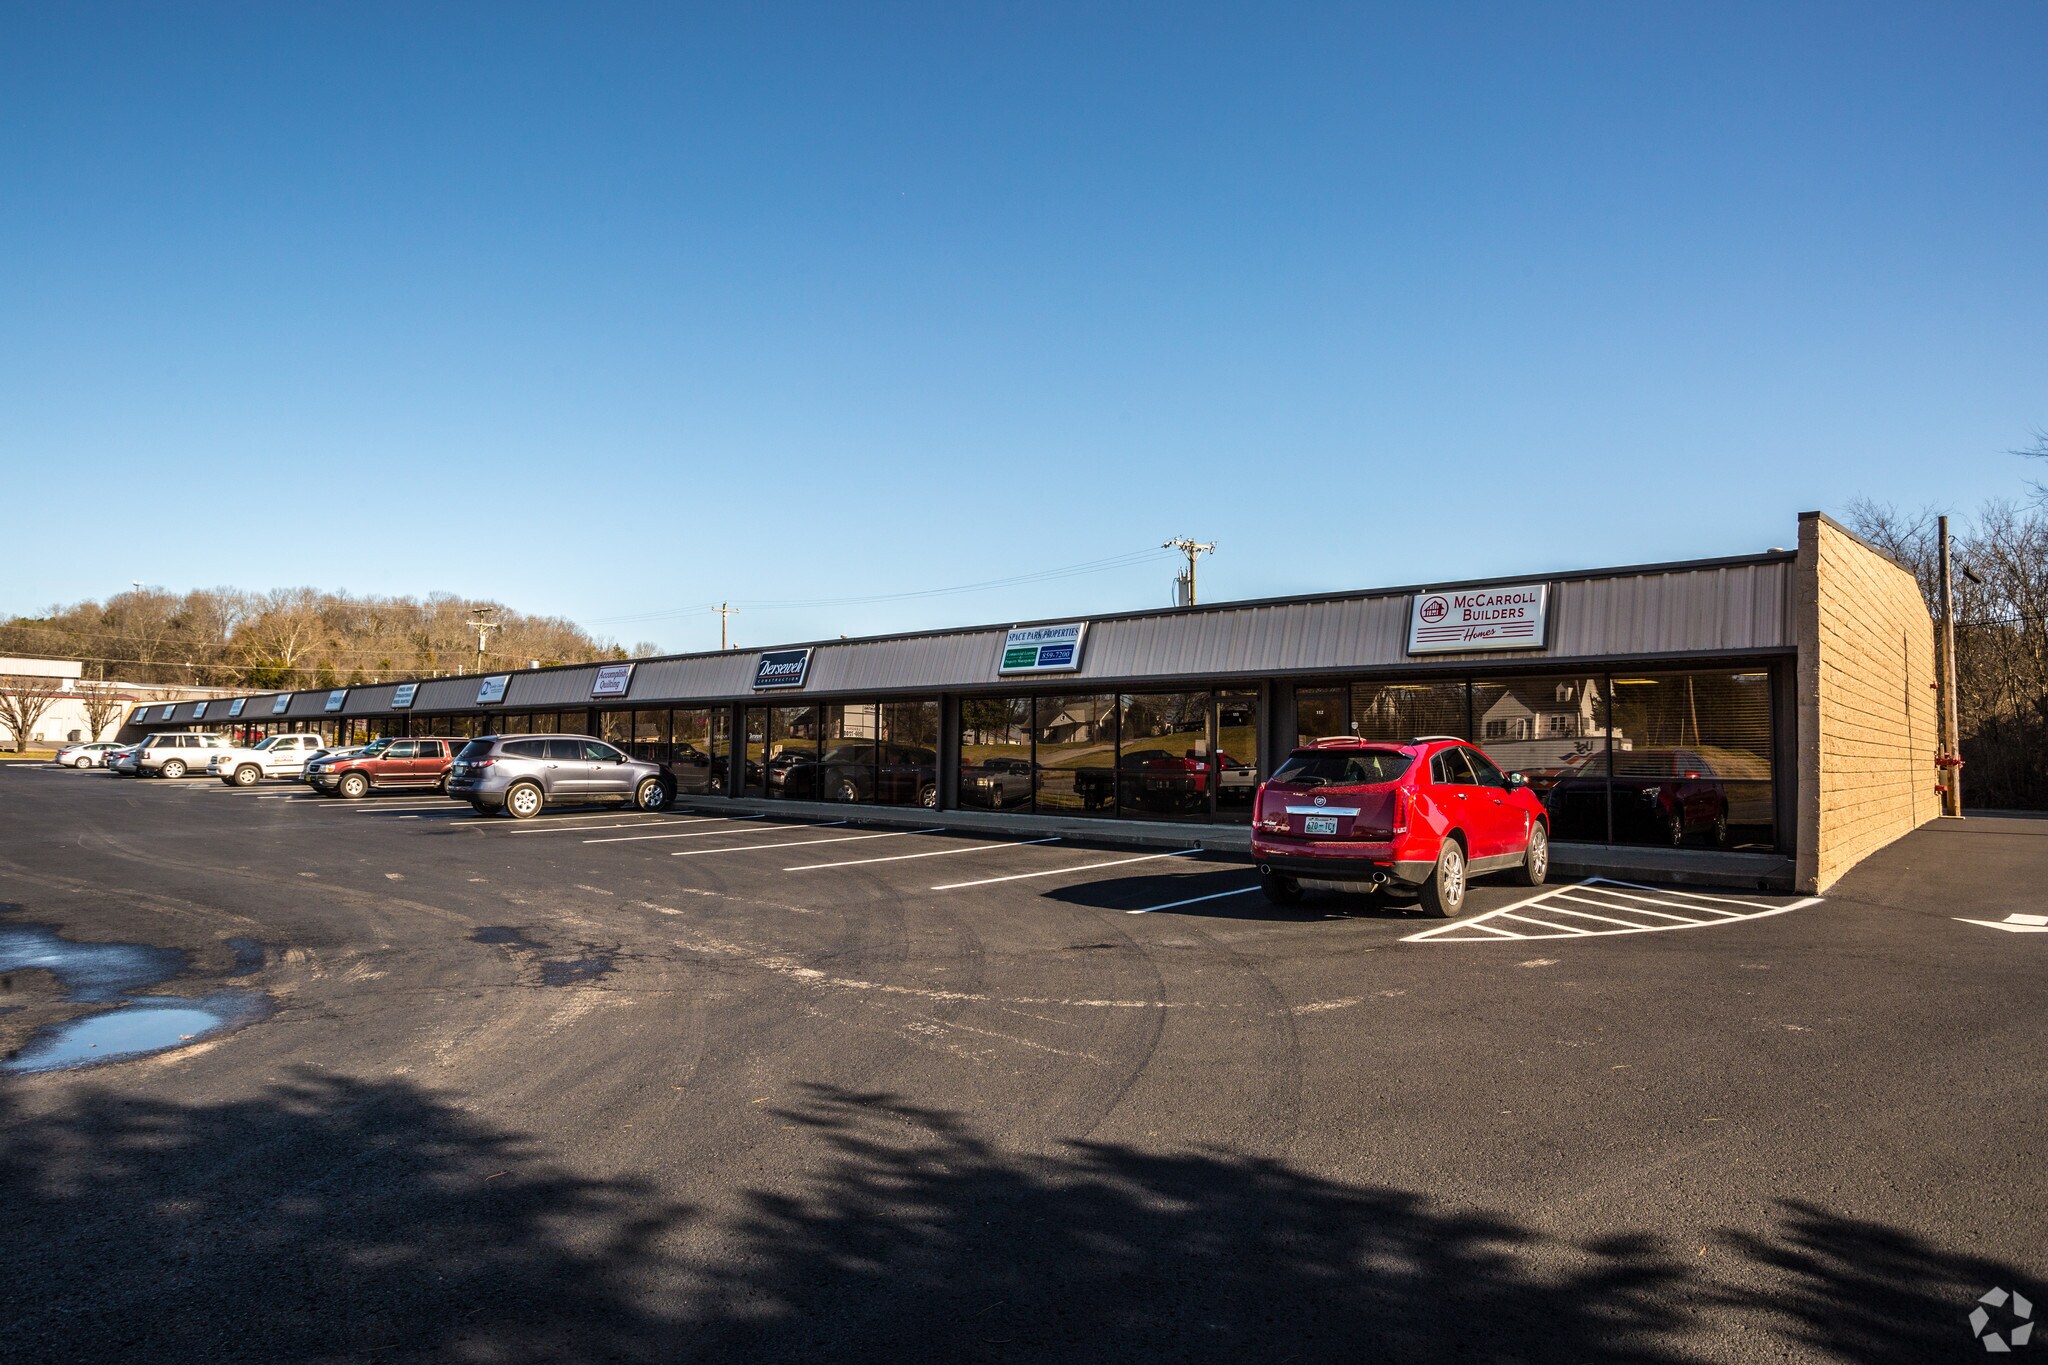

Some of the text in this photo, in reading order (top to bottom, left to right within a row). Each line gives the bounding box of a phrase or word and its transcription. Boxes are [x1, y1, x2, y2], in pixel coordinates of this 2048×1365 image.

[1008, 627, 1079, 642] SPACE PARK PROPERTIES
[1463, 627, 1496, 642] Homes
[1042, 651, 1070, 659] 859-7200
[599, 669, 629, 681] Accomplish
[757, 676, 799, 684] CONSTRUCTION
[599, 680, 621, 690] Quilting
